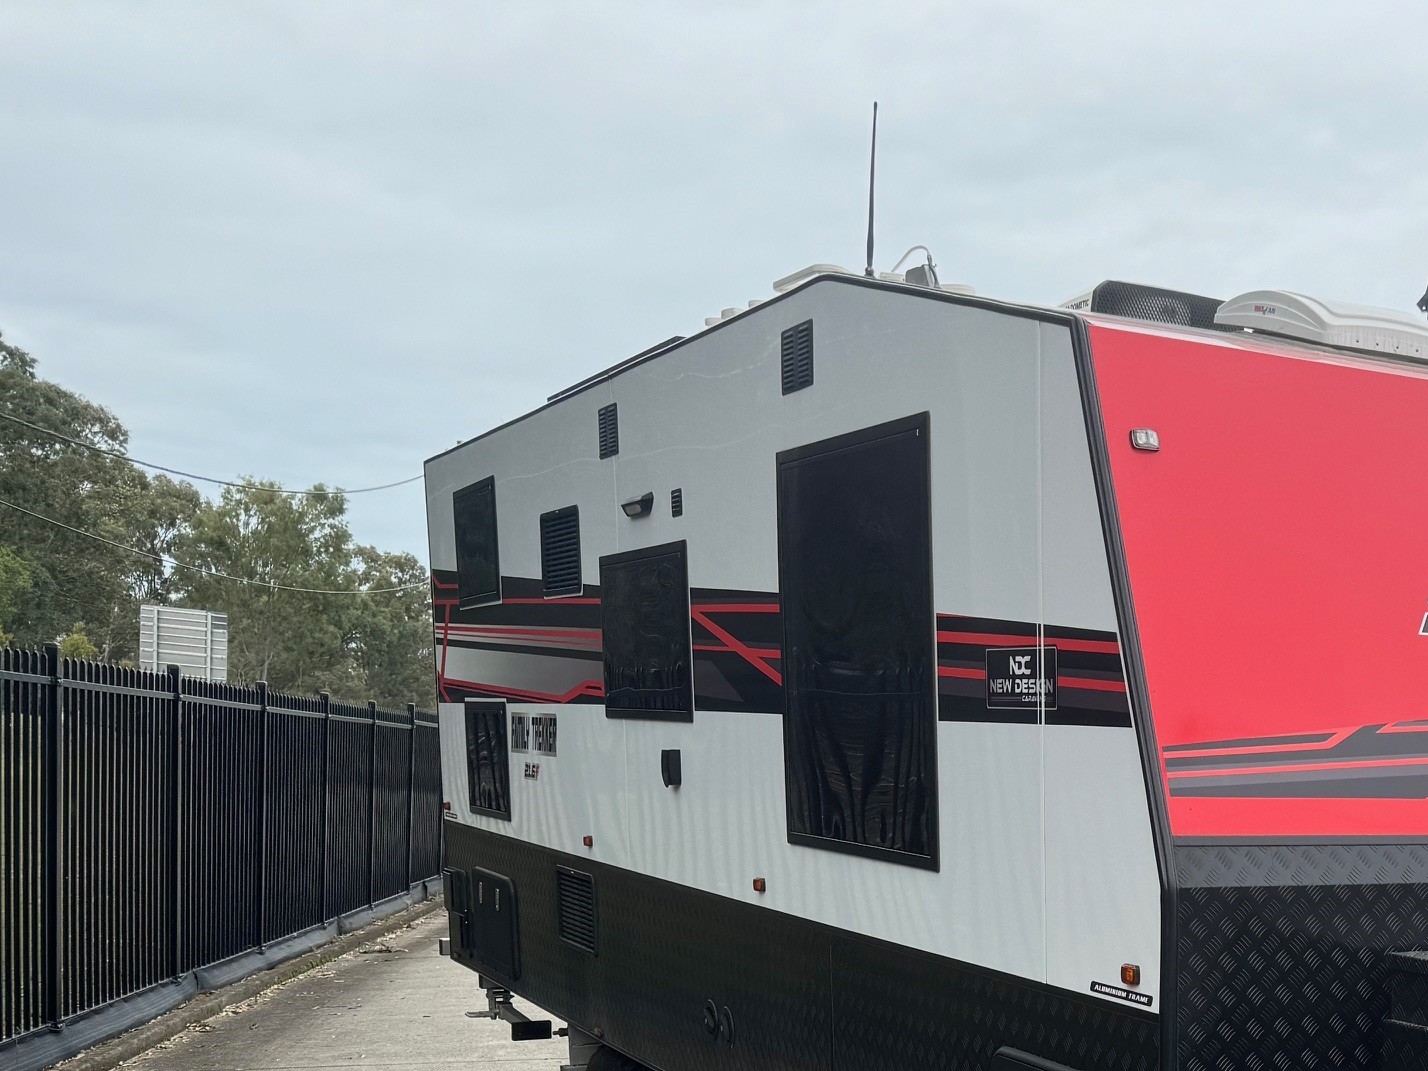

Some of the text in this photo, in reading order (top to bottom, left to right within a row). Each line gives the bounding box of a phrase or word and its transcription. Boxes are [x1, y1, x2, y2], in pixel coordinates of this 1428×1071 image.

[1009, 655, 1032, 676] NDC
[989, 678, 1054, 694] NEW DESIGN
[1128, 993, 1149, 1004] FRAME
